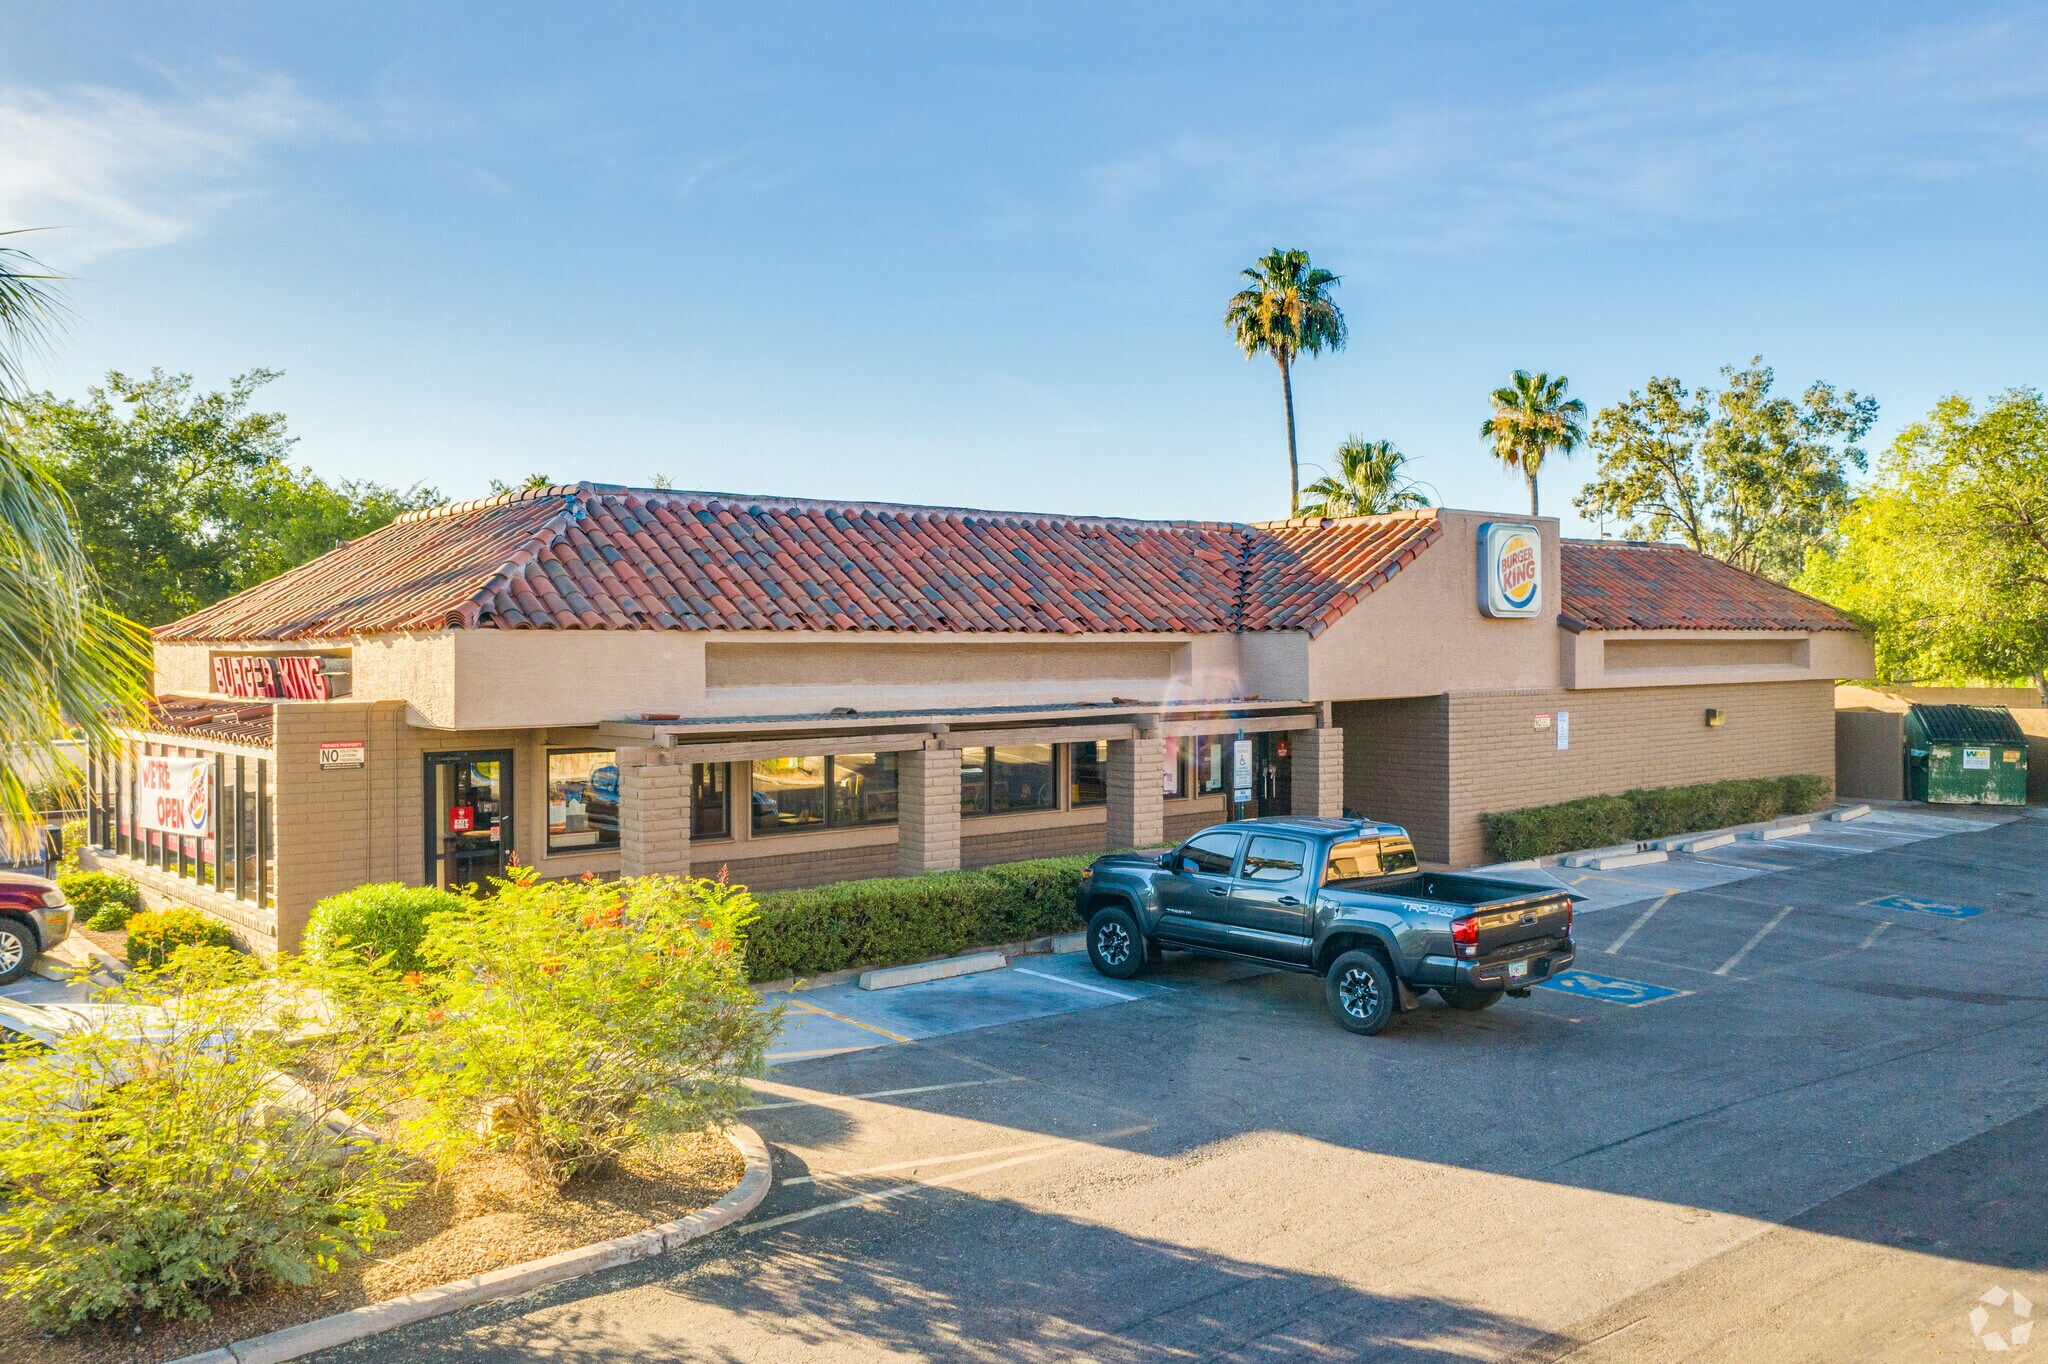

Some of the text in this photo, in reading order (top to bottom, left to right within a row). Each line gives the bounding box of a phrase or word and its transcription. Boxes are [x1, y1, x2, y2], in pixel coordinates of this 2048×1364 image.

[1502, 547, 1534, 573] BURGER
[1503, 560, 1535, 593] KING
[213, 656, 326, 702] BURGER KING
[322, 749, 339, 763] NO
[143, 760, 170, 790] WE'RE
[157, 796, 185, 829] OPEN
[190, 786, 205, 815] KING
[1401, 902, 1429, 913] TRD
